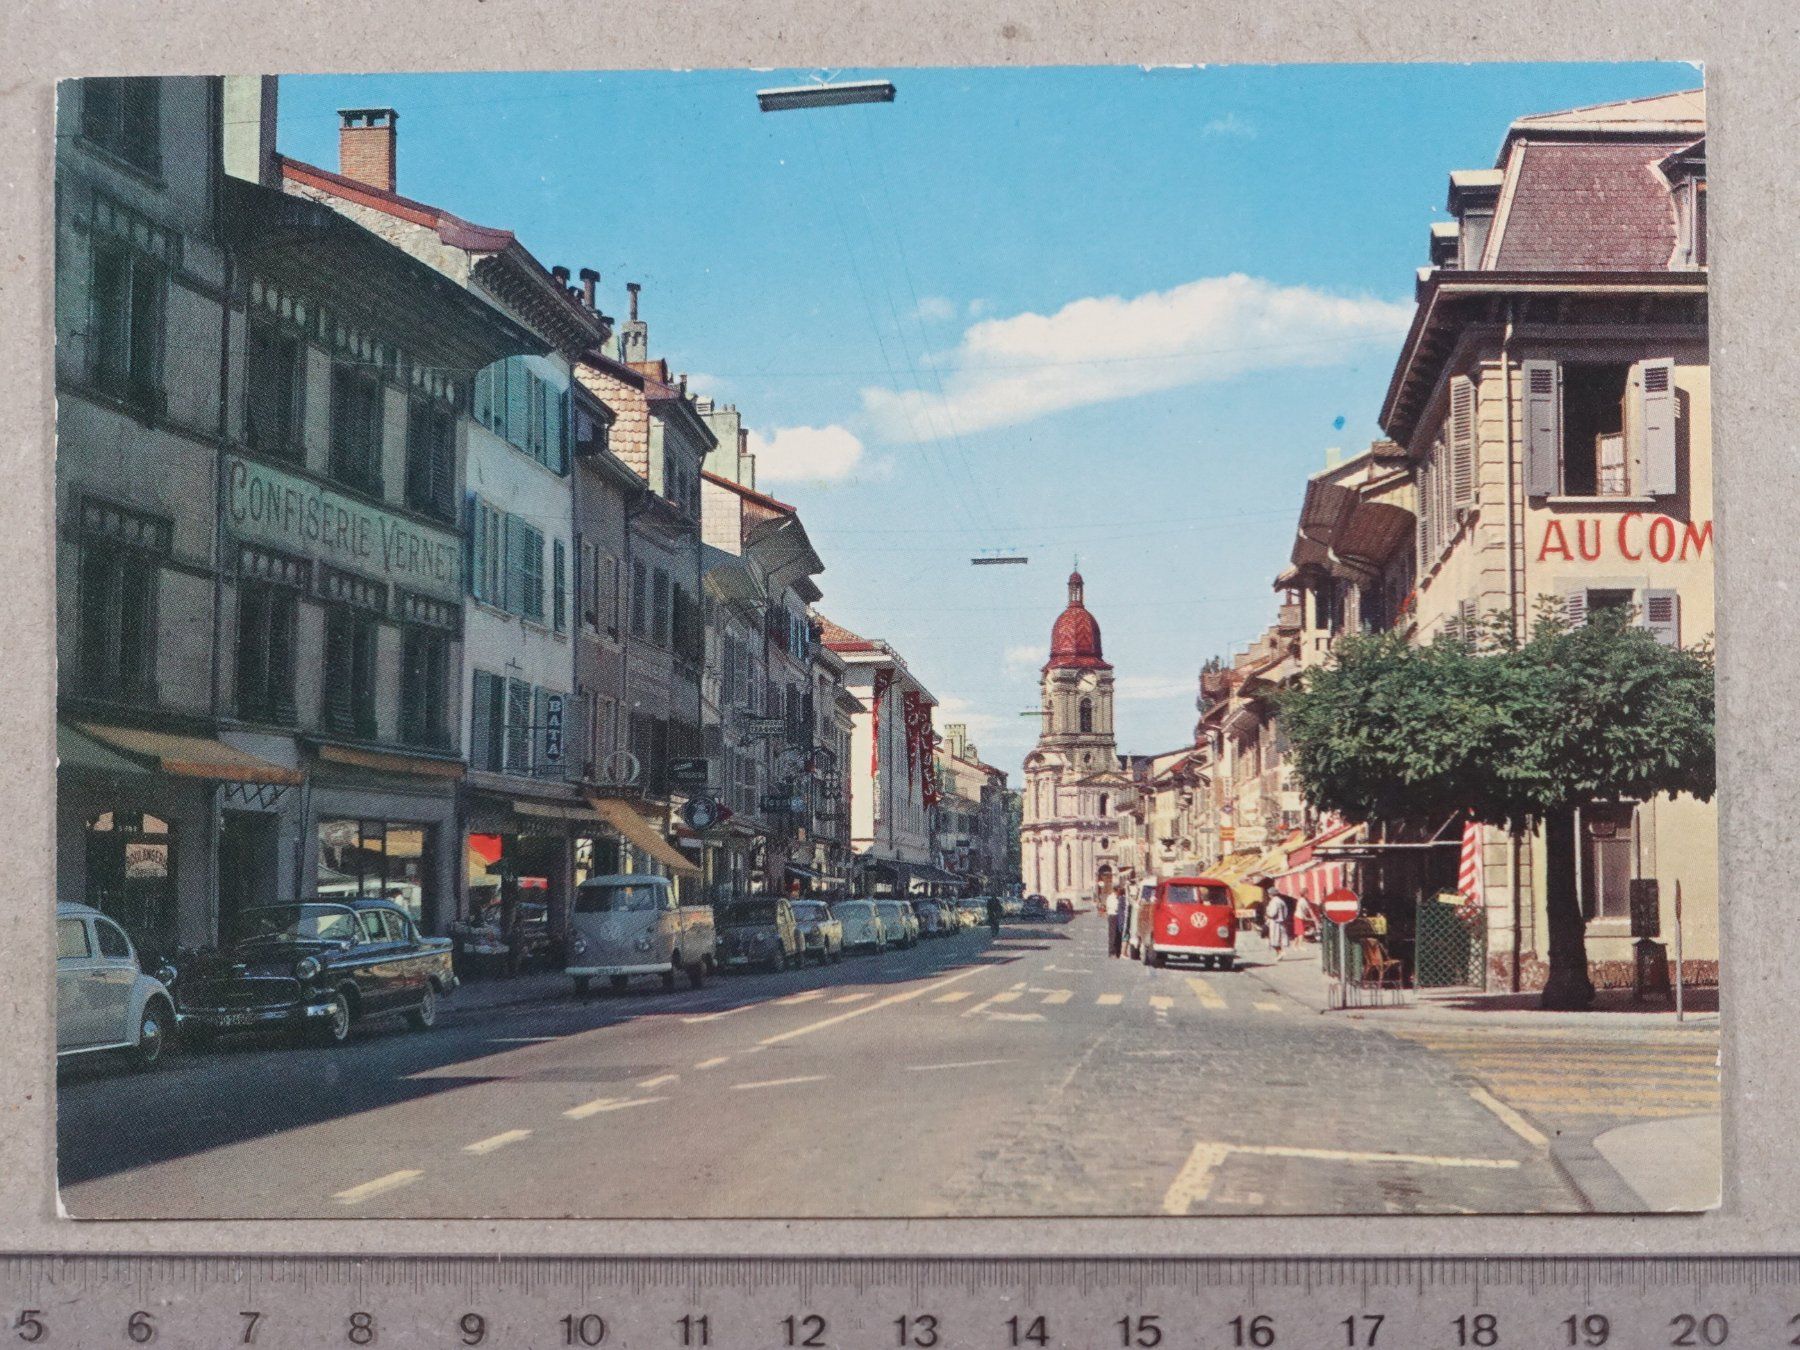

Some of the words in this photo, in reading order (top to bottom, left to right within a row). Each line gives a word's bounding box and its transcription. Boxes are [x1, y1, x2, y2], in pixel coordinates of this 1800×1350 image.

[229, 460, 371, 558] CONFISERIE
[378, 515, 458, 584] VERNET
[1536, 519, 1601, 562] AU
[1617, 511, 1713, 563] COM
[547, 700, 561, 755] BATA
[18, 1309, 43, 1342] 5
[127, 1310, 153, 1343] 6
[239, 1311, 260, 1344] 7
[348, 1311, 373, 1345] 8
[459, 1312, 485, 1346] 9
[559, 1313, 605, 1347] 10
[676, 1314, 709, 1347] 11
[783, 1314, 827, 1348] 12
[894, 1314, 939, 1348] 13
[1006, 1314, 1051, 1348] 14
[1117, 1315, 1163, 1348] 15
[1229, 1315, 1276, 1348] 16
[1341, 1314, 1386, 1348] 17
[1452, 1313, 1499, 1347] 18
[1564, 1314, 1610, 1347] 19
[1671, 1313, 1729, 1347] 20
